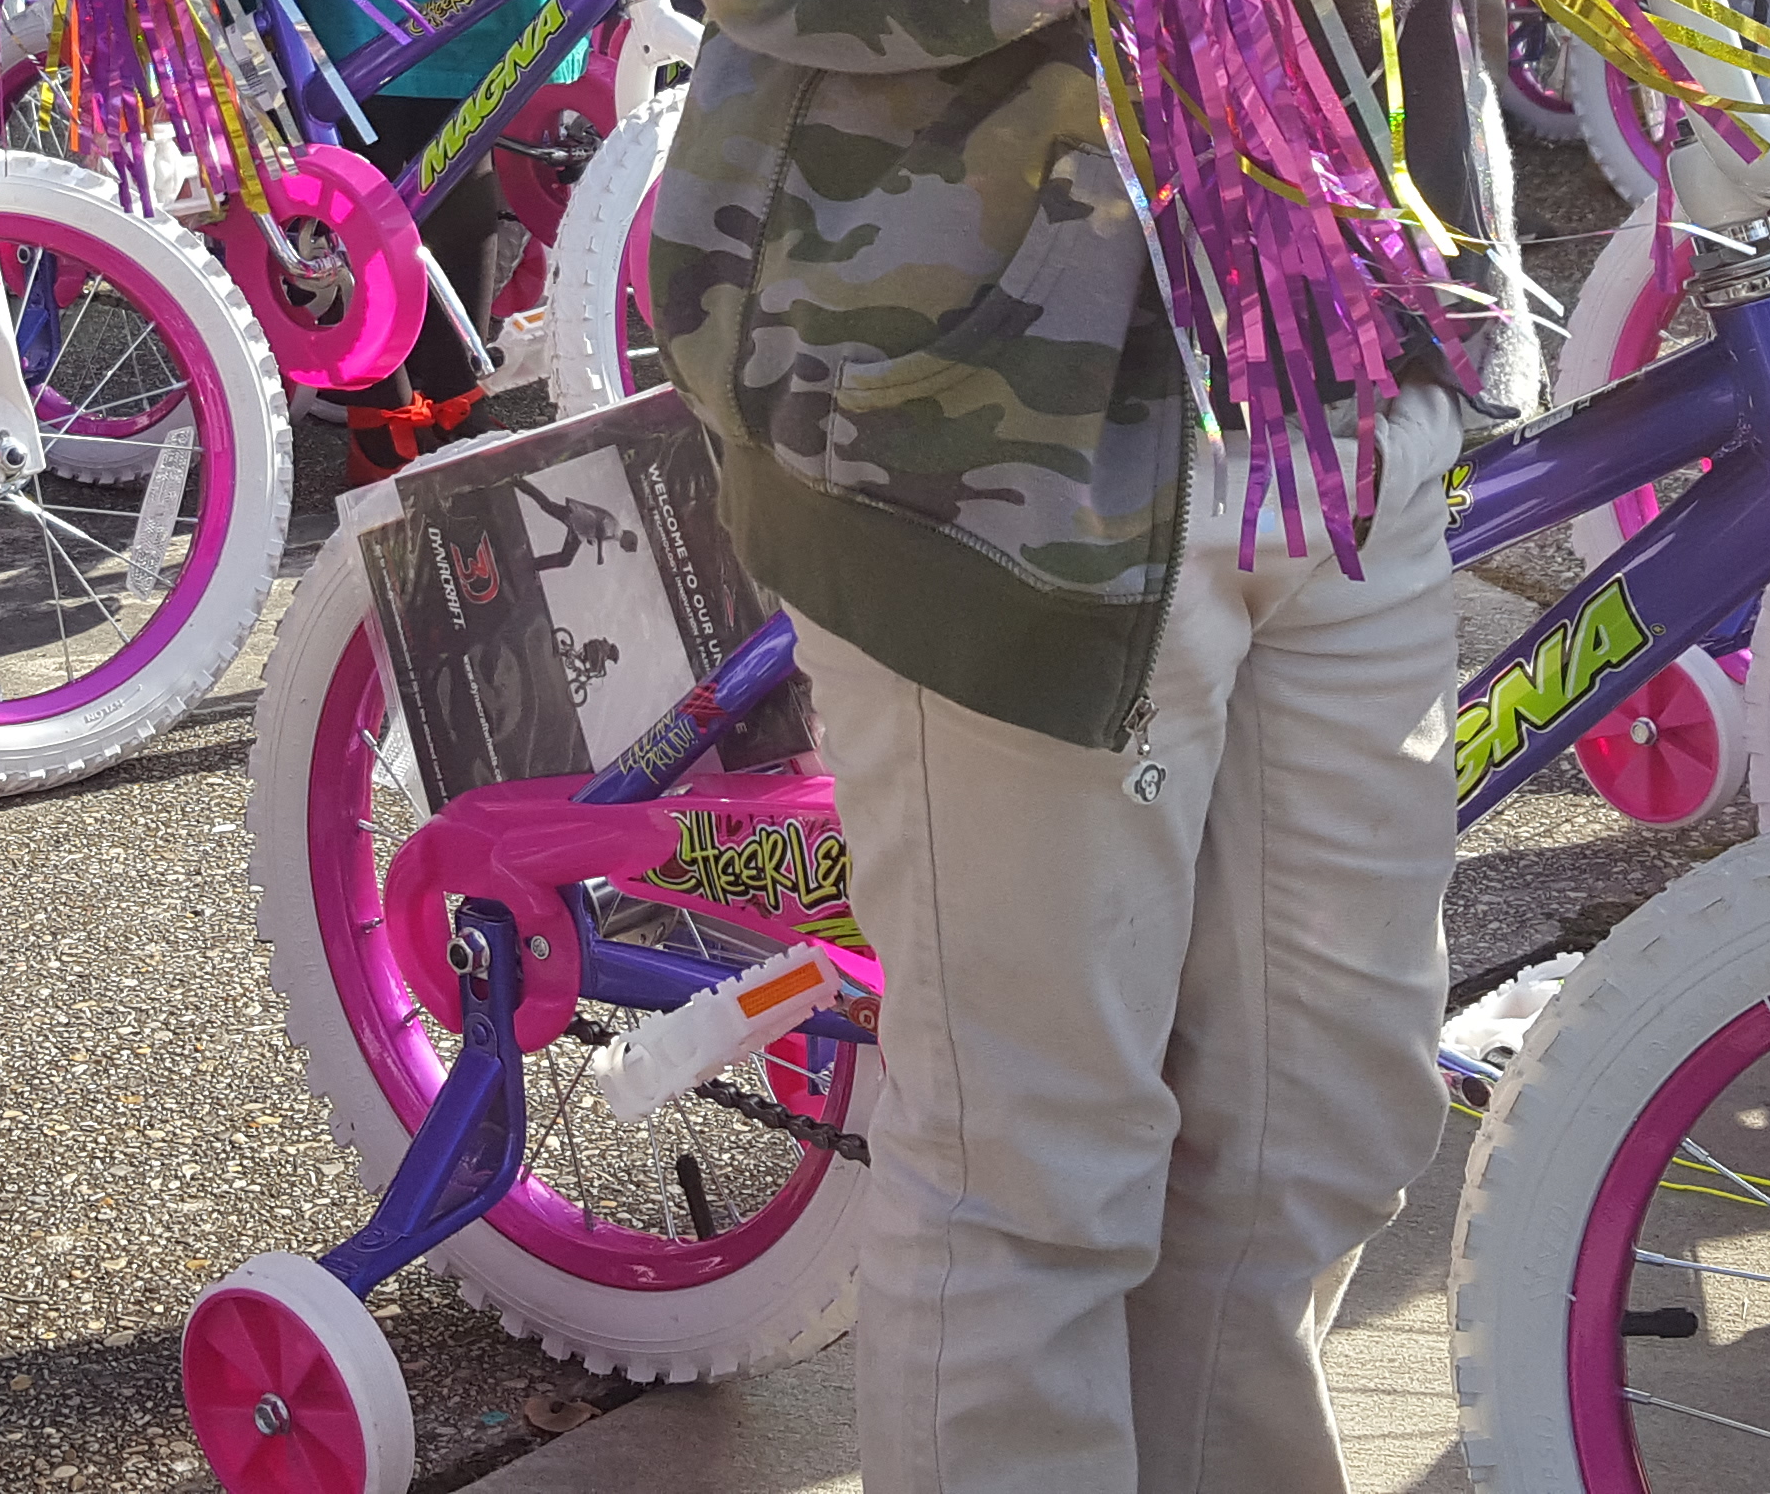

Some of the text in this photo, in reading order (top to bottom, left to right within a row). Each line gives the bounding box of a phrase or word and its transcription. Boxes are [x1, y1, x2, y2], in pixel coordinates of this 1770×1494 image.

[428, 526, 466, 630] DYNACRAFT
[648, 463, 713, 635] WELCOME TO OUR
[463, 654, 504, 783] www.dynacraftwheels.co
[1457, 571, 1654, 806] GNA
